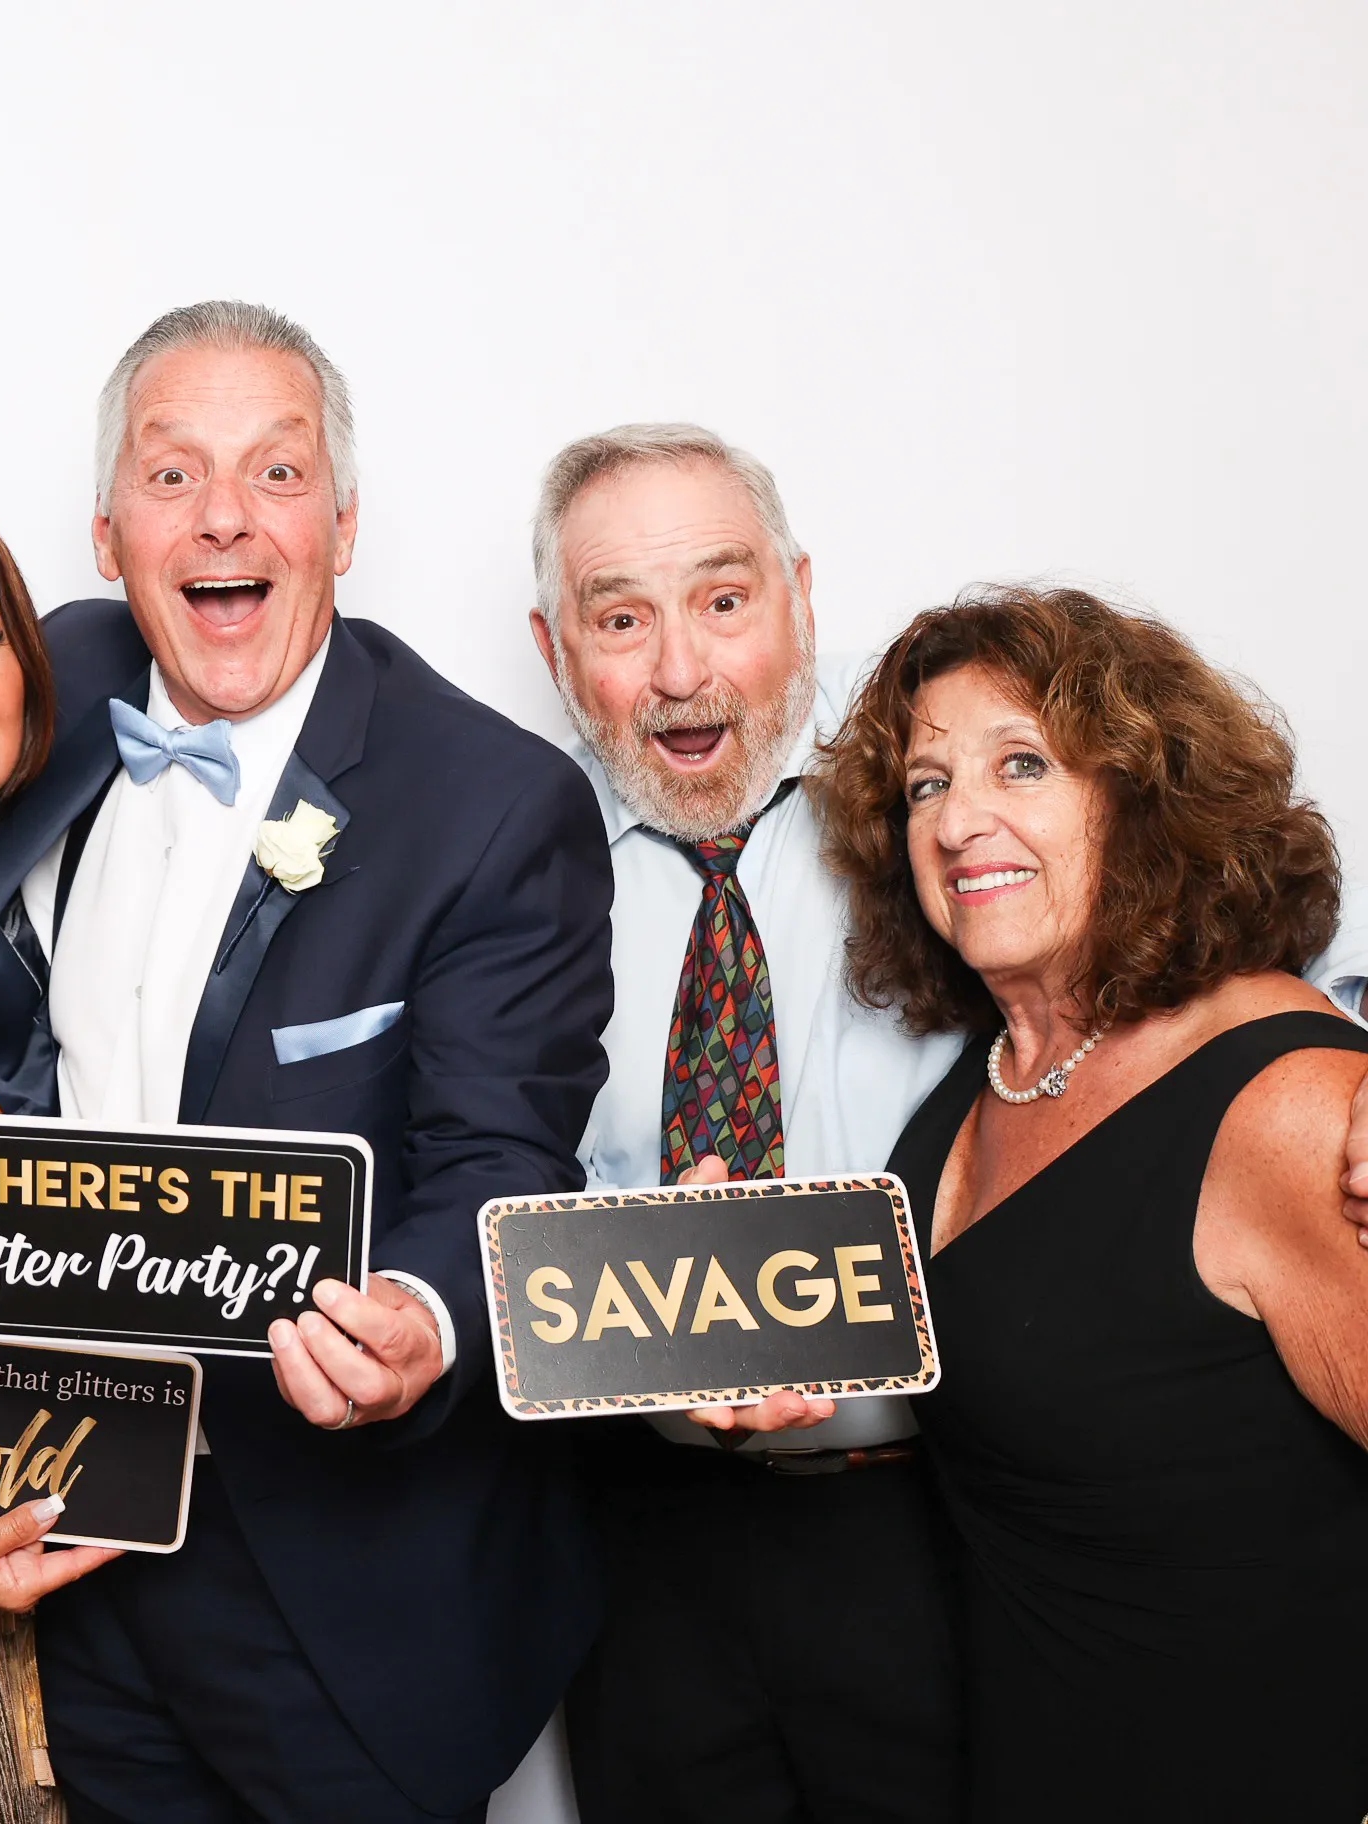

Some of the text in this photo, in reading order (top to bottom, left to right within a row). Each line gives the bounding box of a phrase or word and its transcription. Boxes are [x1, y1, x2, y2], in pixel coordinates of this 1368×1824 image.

[211, 1170, 322, 1223] THE
[98, 1232, 321, 1320] Party?!
[525, 1243, 894, 1344] SAVAGE
[56, 1371, 155, 1402] glitters
[163, 1380, 185, 1406] is
